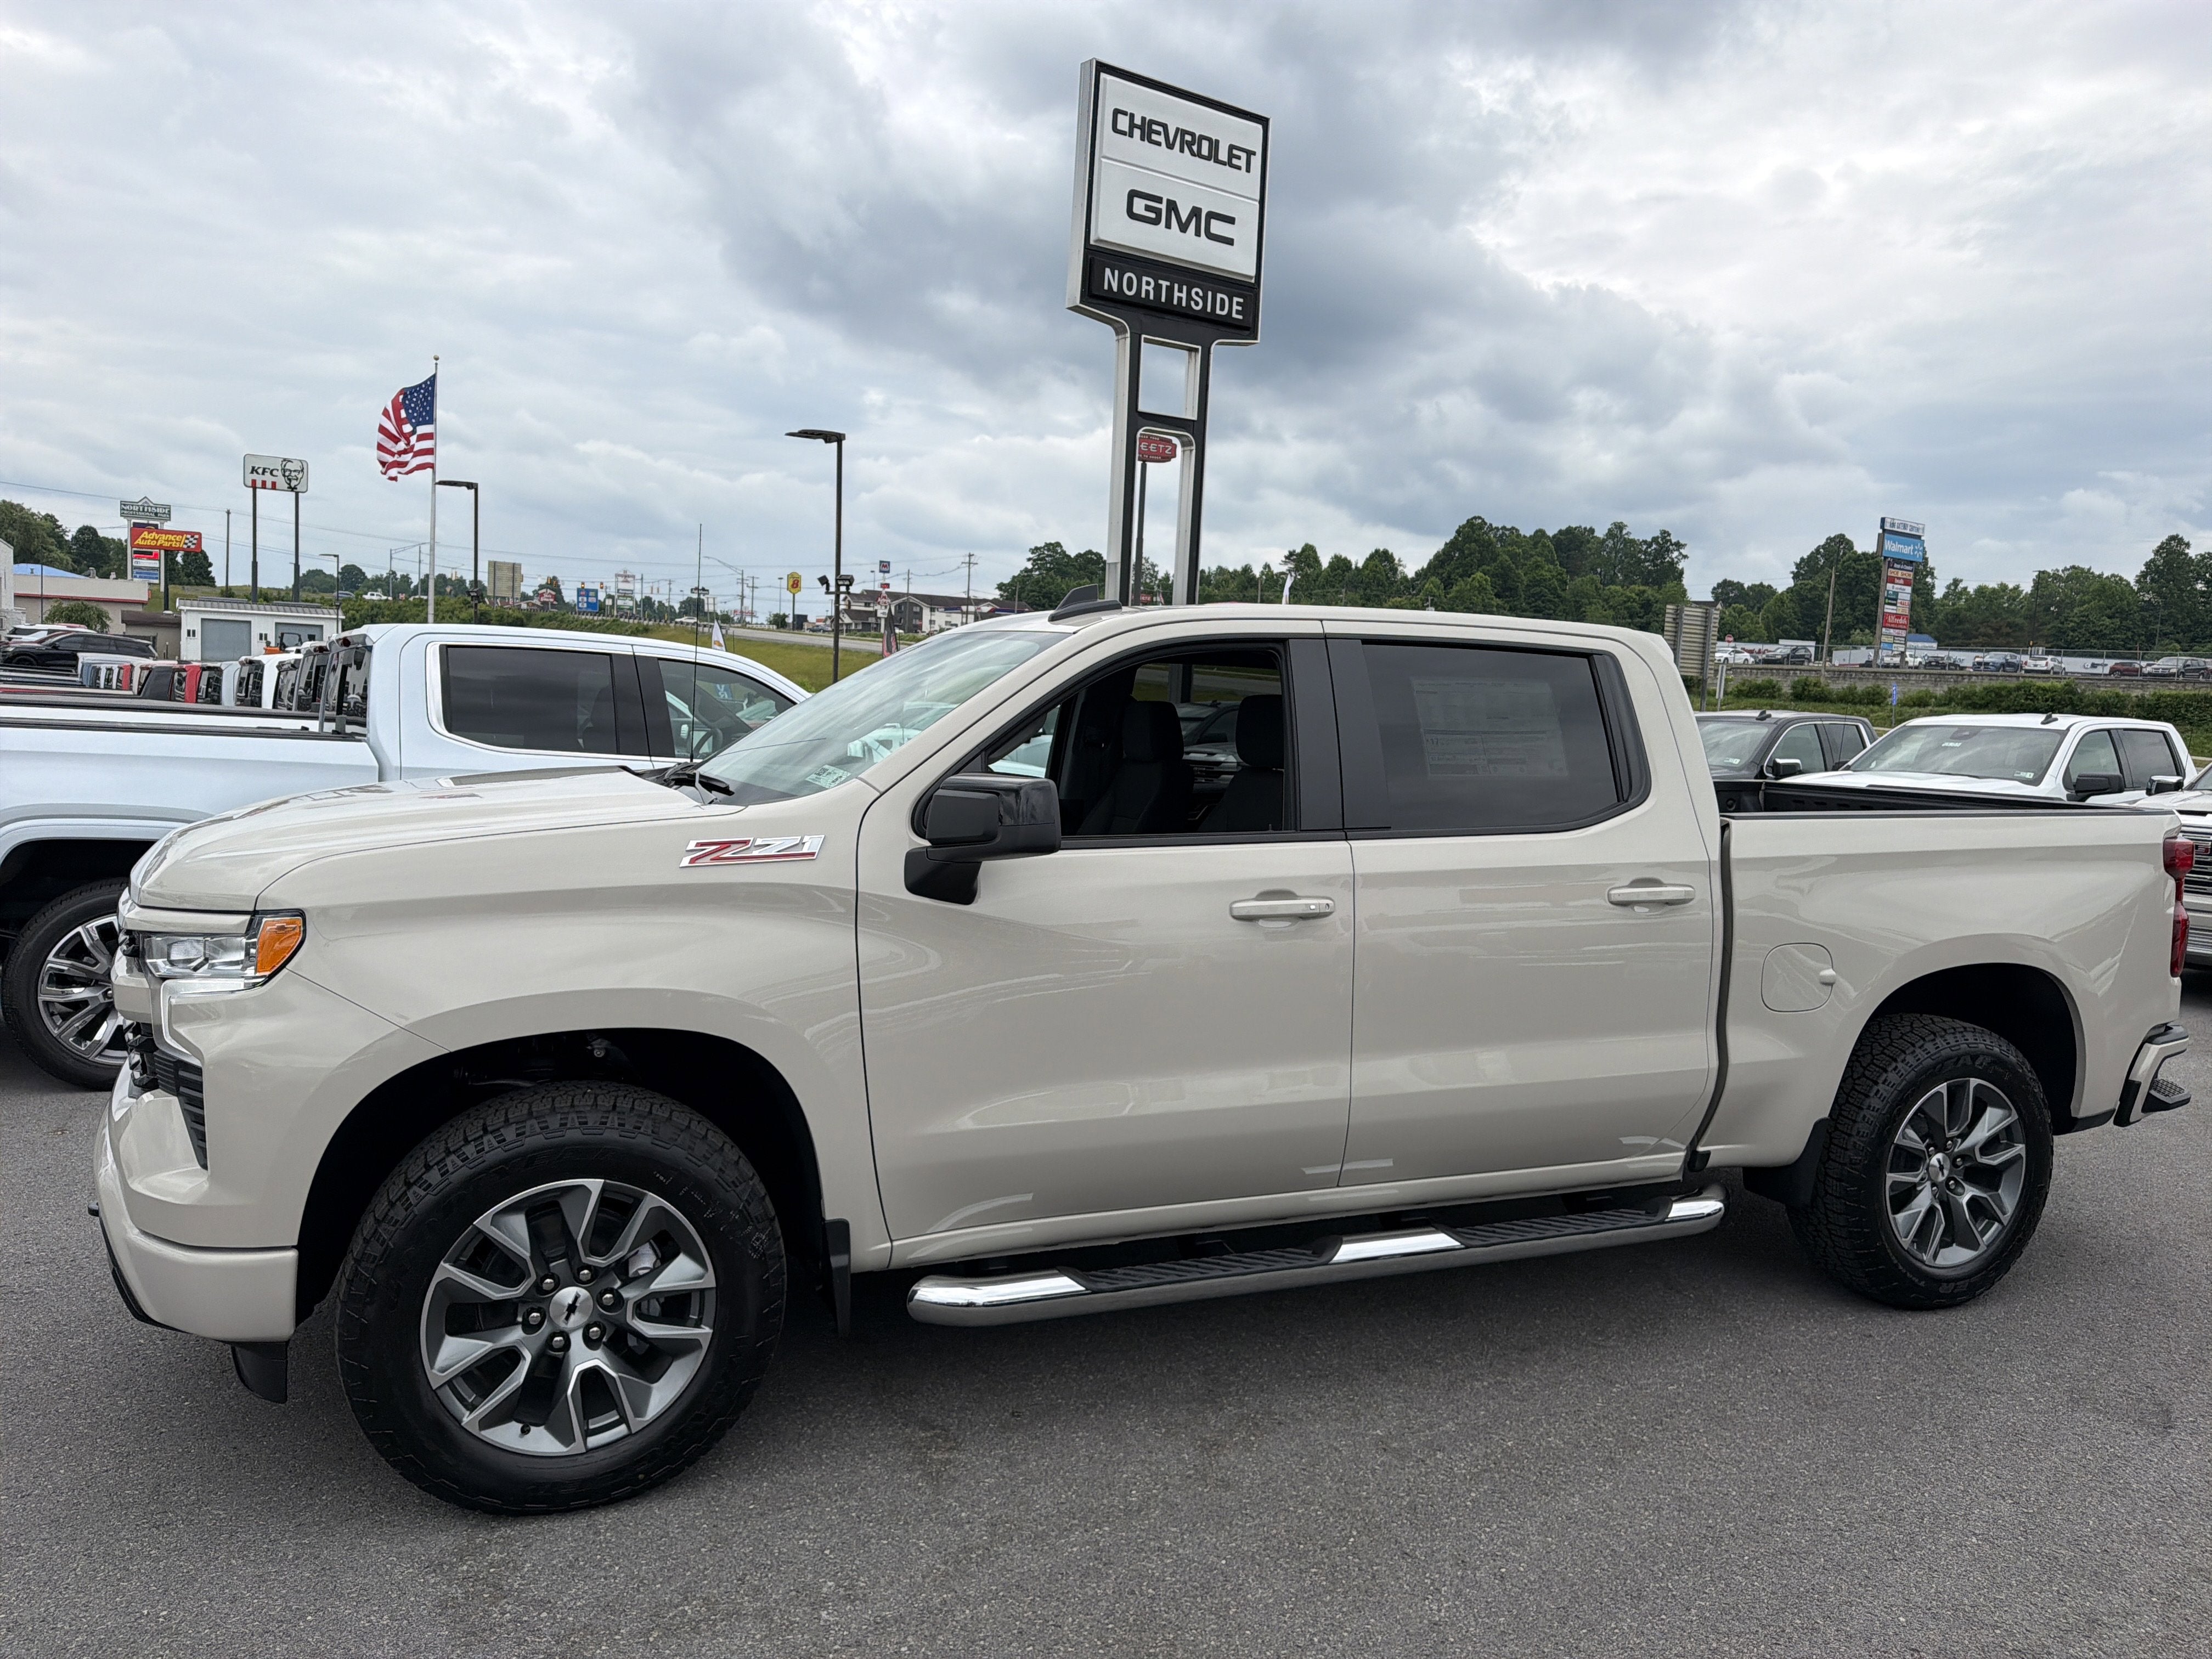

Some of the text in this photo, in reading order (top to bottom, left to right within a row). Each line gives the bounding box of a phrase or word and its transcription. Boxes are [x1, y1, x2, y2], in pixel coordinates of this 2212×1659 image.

[1111, 108, 1256, 173] CHEVROLET
[1126, 189, 1236, 246] GMC
[1104, 267, 1244, 320] NORTHSIDE
[1140, 442, 1172, 454] EETZ
[249, 465, 279, 477] KFC
[121, 504, 170, 514] NORTHSIDE
[139, 531, 182, 541] Advance
[157, 539, 180, 548] Parts
[1884, 539, 1914, 555] Walmart
[791, 579, 799, 589] 8
[679, 834, 825, 867] Z71
